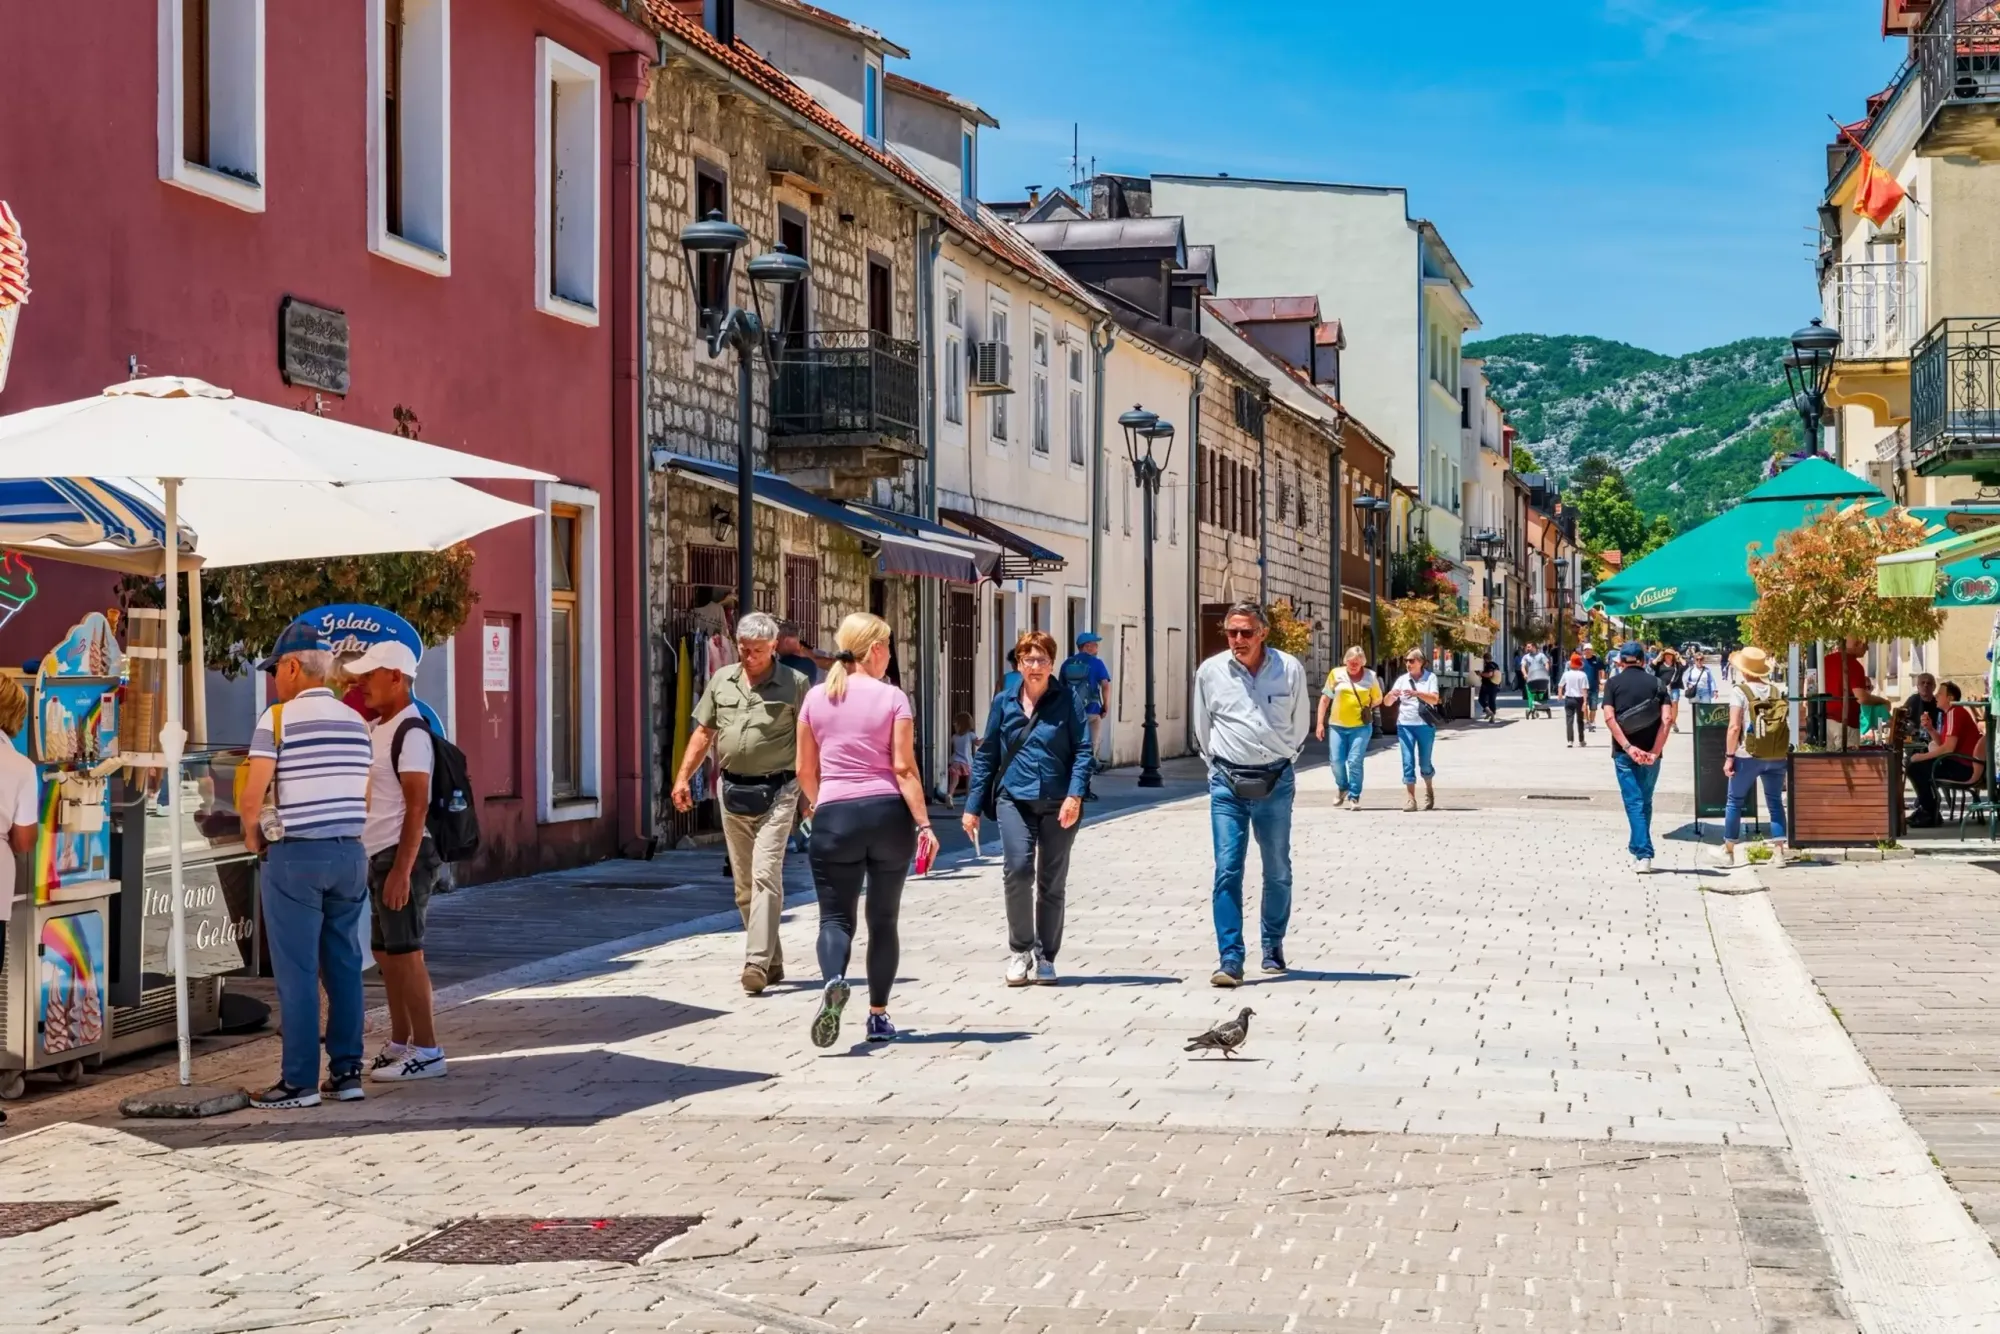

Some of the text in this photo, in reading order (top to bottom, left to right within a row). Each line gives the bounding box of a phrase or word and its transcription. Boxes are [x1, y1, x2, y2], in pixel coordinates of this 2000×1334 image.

[317, 611, 381, 636] Gelato
[143, 884, 216, 917] Itaano
[196, 916, 253, 950] Gelato
